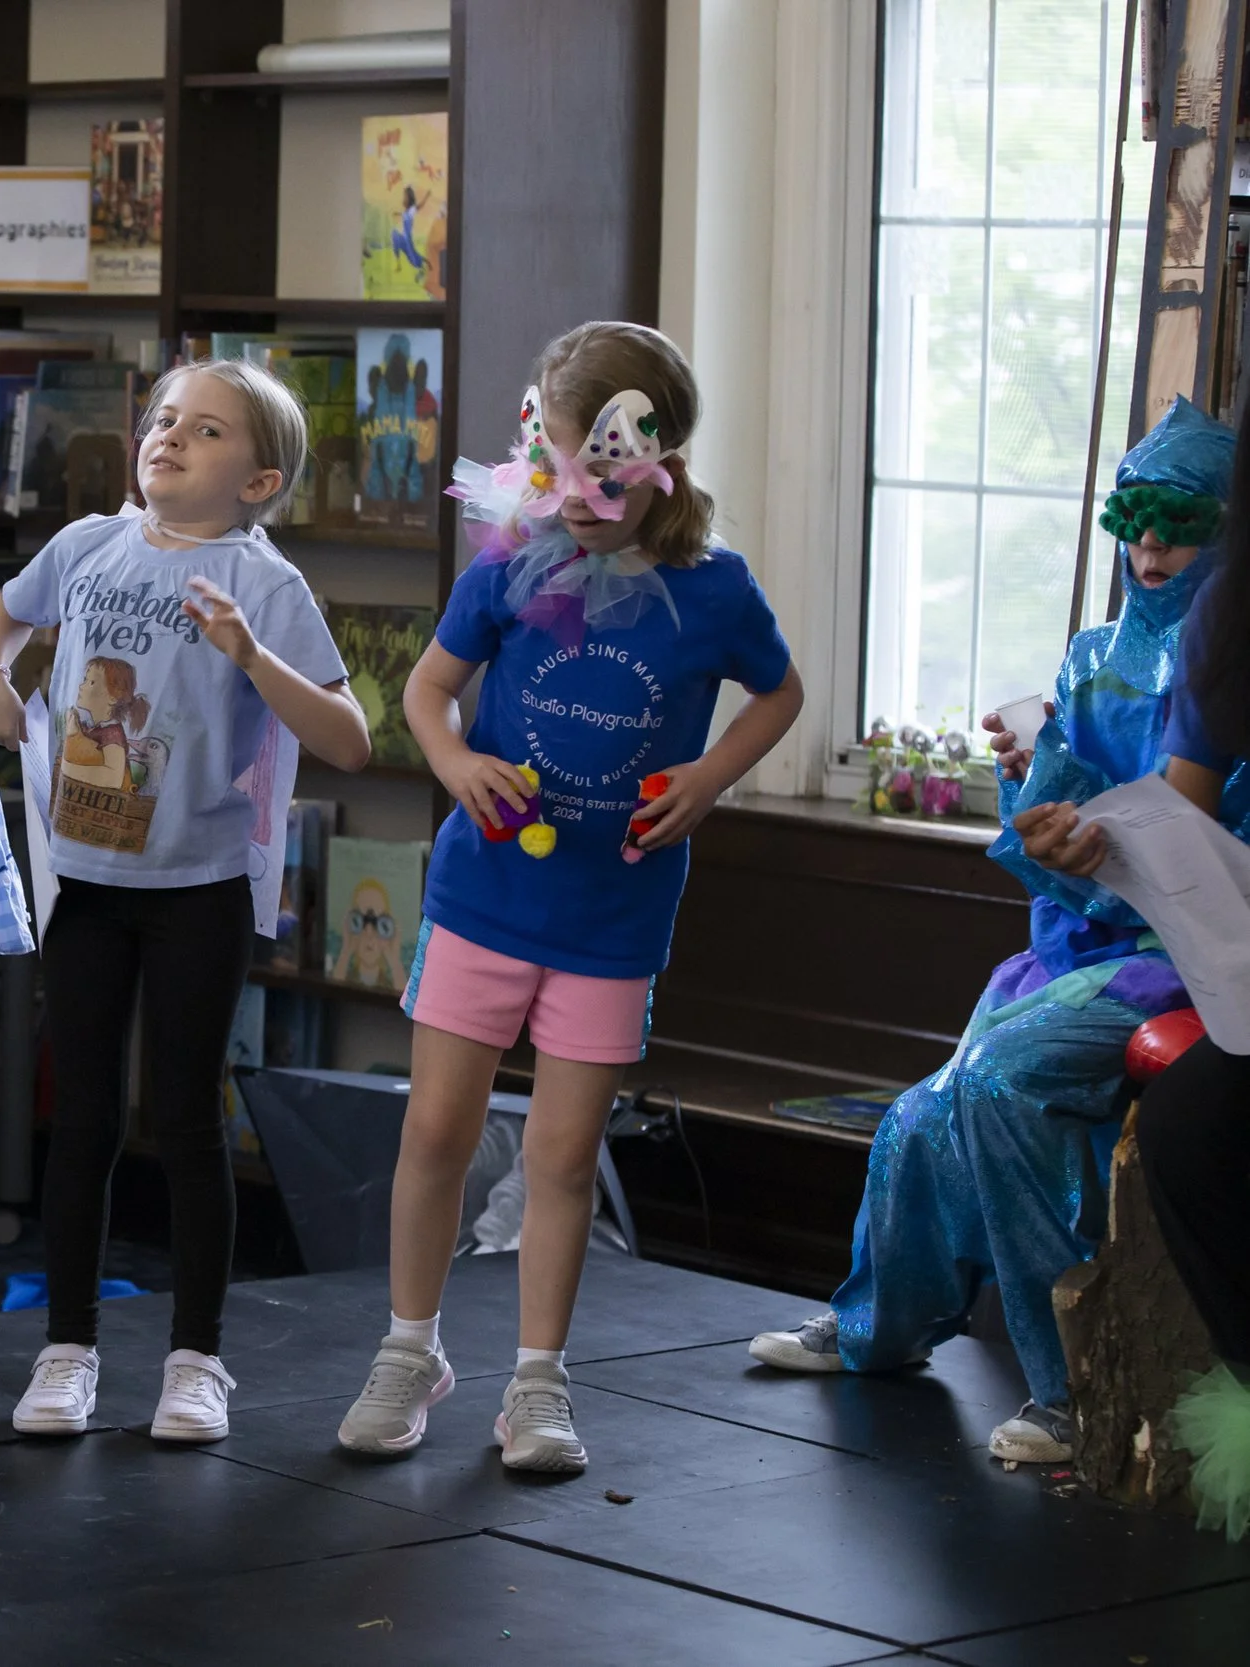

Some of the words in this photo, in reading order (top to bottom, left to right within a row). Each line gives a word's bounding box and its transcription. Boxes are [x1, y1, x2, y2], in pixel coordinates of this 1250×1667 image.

[82, 614, 153, 655] Web
[530, 645, 580, 684] LAUGH
[587, 643, 629, 663] SING
[631, 661, 663, 703] MAKE
[521, 689, 567, 716] Studio
[570, 703, 664, 731] Playground
[526, 732, 593, 787] BEAUTIFUL
[601, 741, 651, 784] RUCKUS
[543, 789, 584, 807] WOODS
[585, 799, 617, 811] STATE
[552, 805, 583, 821] 2024
